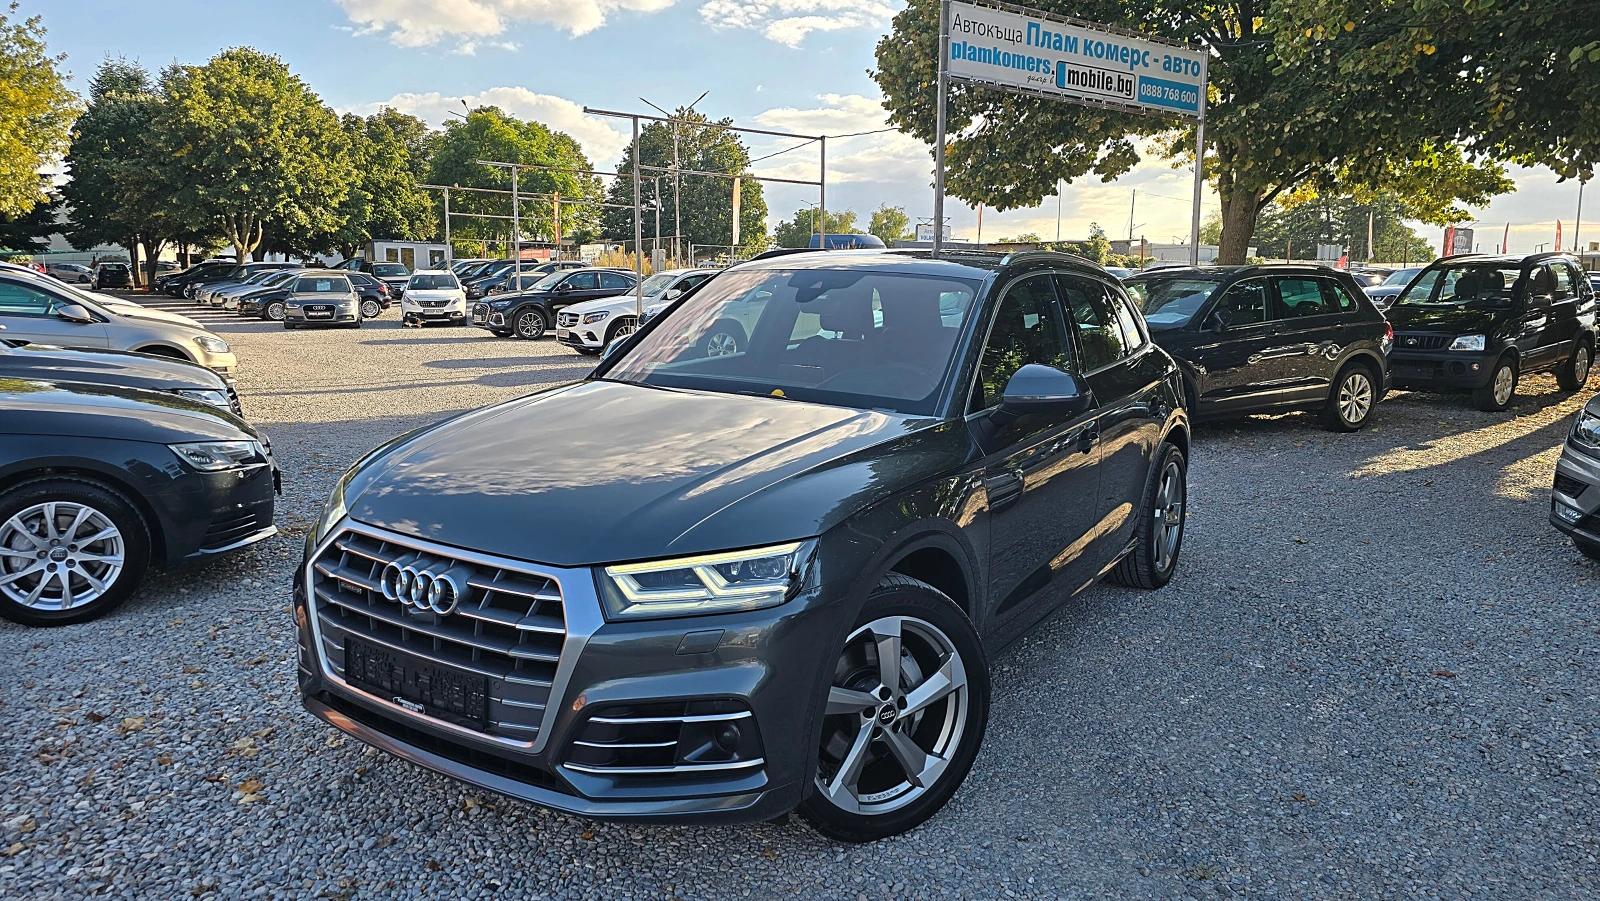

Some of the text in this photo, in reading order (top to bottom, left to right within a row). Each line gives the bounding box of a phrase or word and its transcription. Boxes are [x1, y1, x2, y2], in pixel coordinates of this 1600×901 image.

[952, 13, 1023, 46] Автокъща
[1026, 21, 1078, 54] Плам
[1083, 39, 1150, 71] комерс
[1163, 54, 1201, 77] авто
[1067, 69, 1132, 96] mobile.bg
[1141, 83, 1197, 104] 0888 768 600
